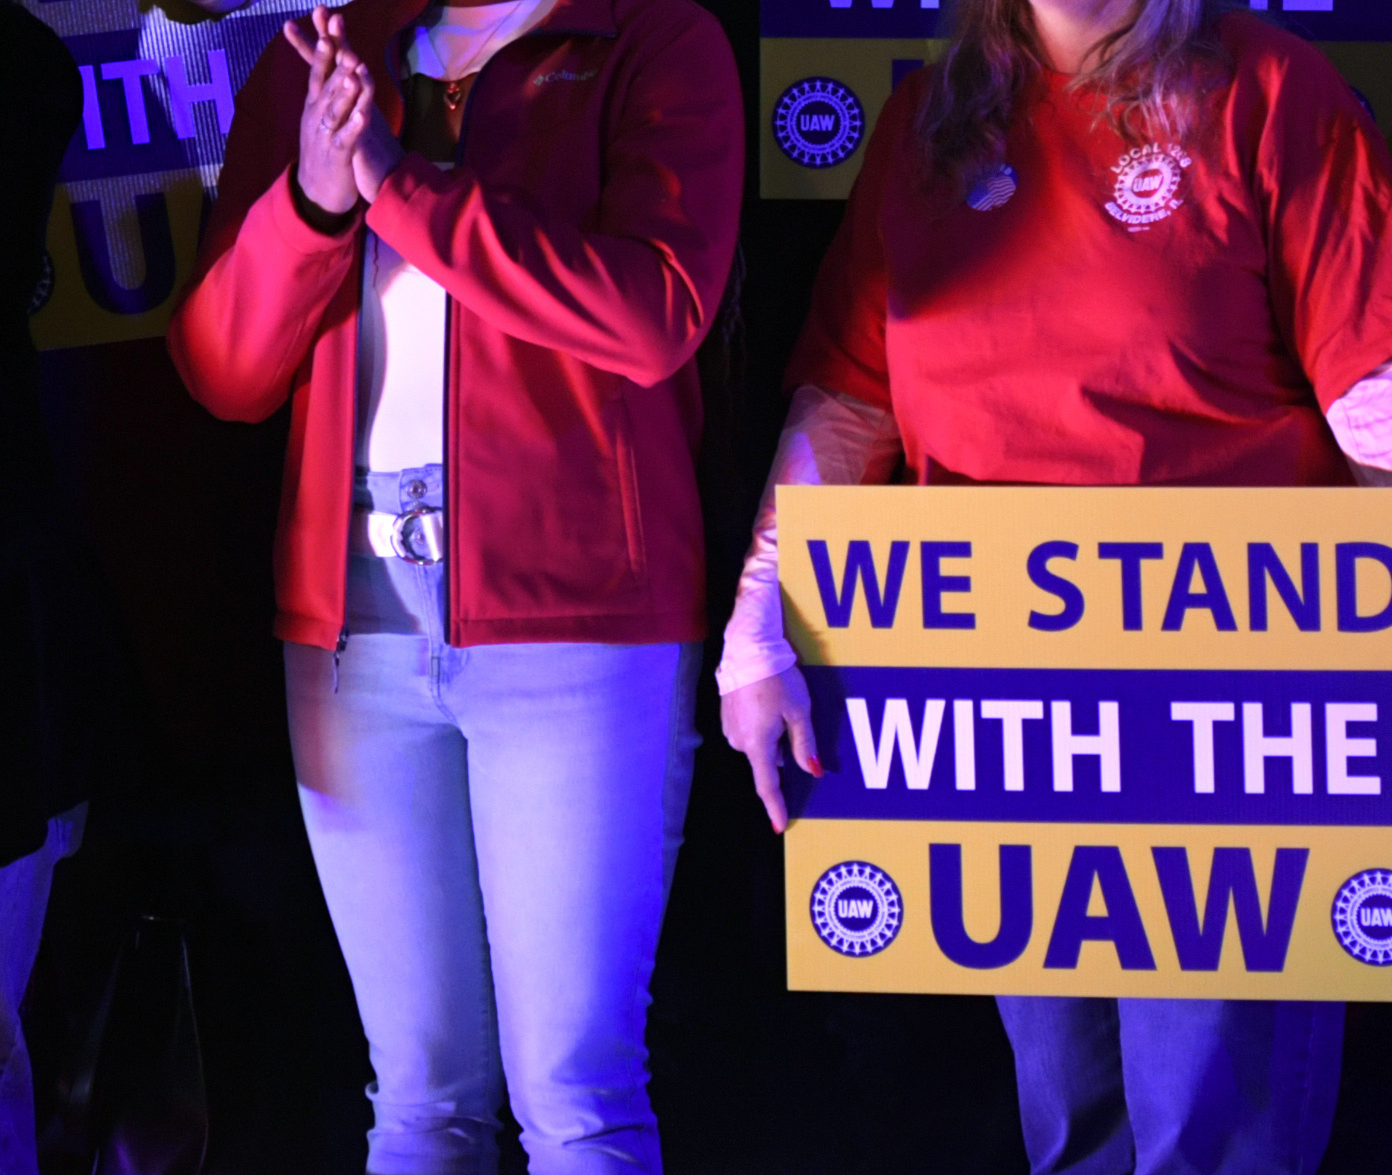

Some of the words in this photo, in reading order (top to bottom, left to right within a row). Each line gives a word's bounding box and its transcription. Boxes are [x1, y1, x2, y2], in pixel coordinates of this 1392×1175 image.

[79, 49, 235, 151] ITH
[800, 114, 836, 132] UAW
[1110, 142, 1162, 174] LOCAL
[1132, 174, 1164, 193] UAW
[806, 540, 977, 630] WE
[845, 697, 1122, 793] WITH
[1170, 701, 1382, 795] THE
[838, 899, 874, 919] UAW
[928, 843, 1310, 973] UAW
